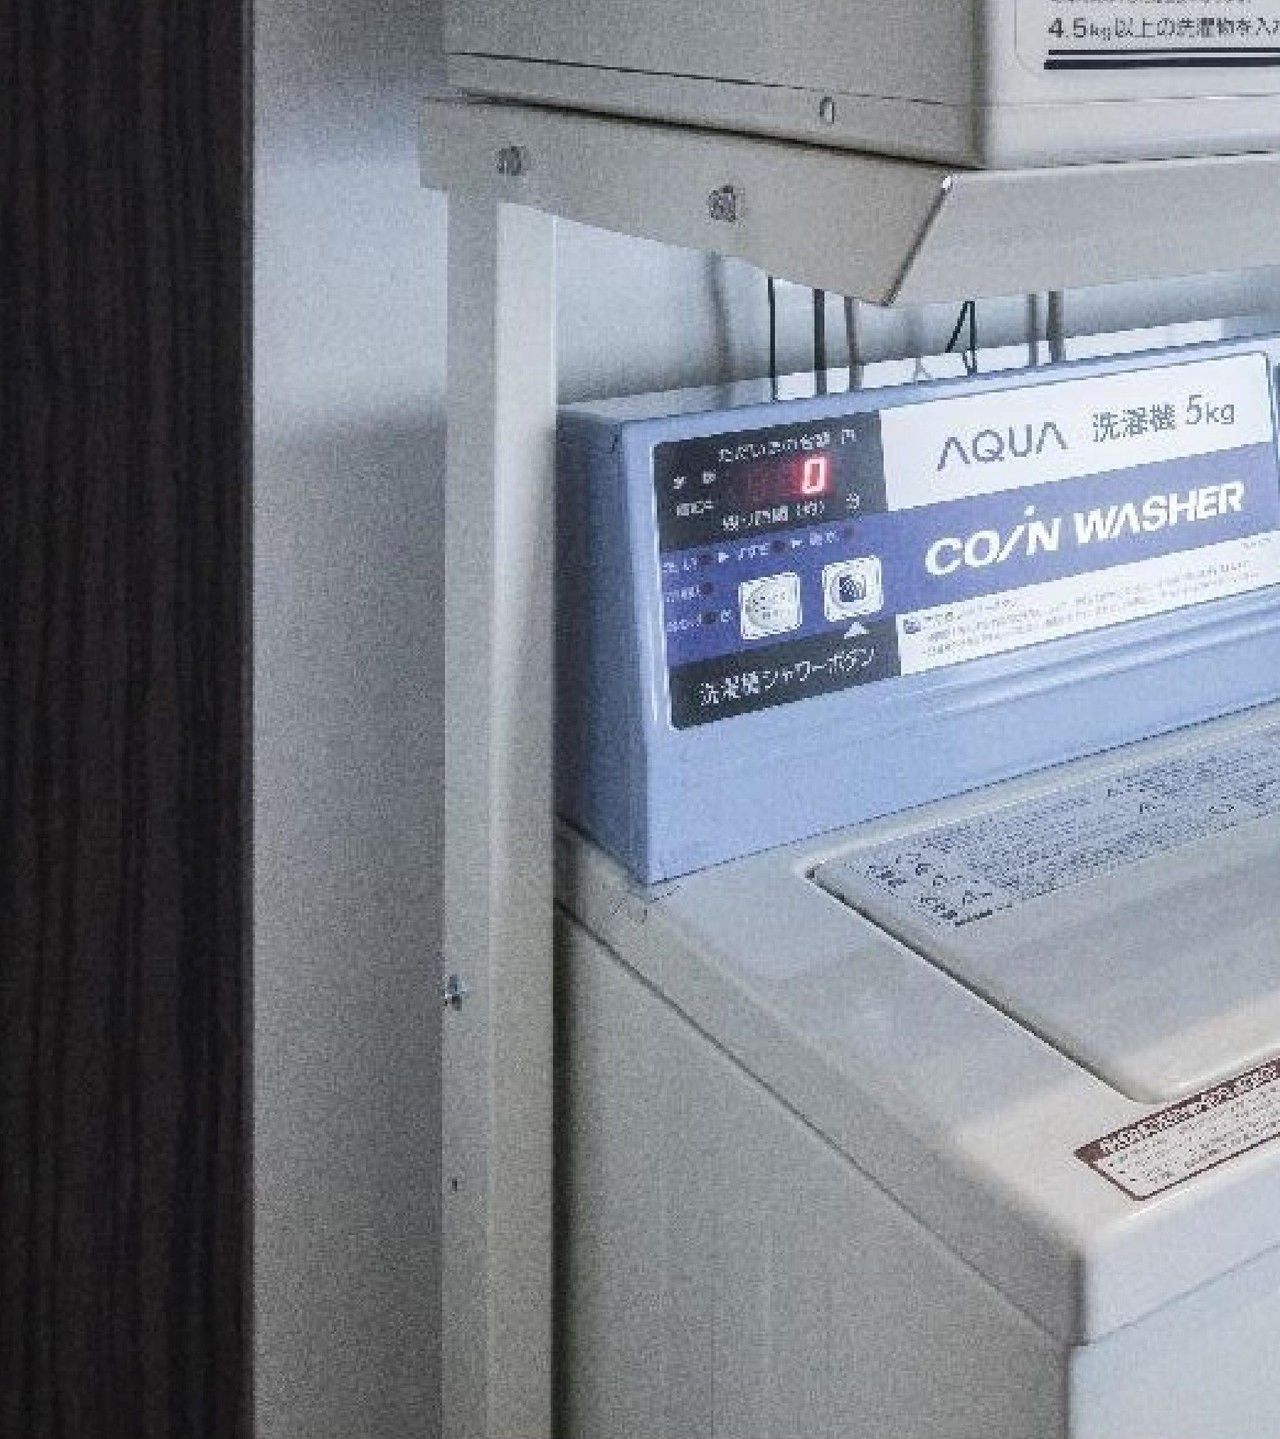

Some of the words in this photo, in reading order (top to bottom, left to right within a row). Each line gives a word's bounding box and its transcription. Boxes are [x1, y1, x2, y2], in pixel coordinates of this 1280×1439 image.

[937, 421, 1068, 471] AQUA
[802, 456, 826, 495] 0
[925, 505, 1062, 576] COIN
[1073, 481, 1245, 545] WASHER
